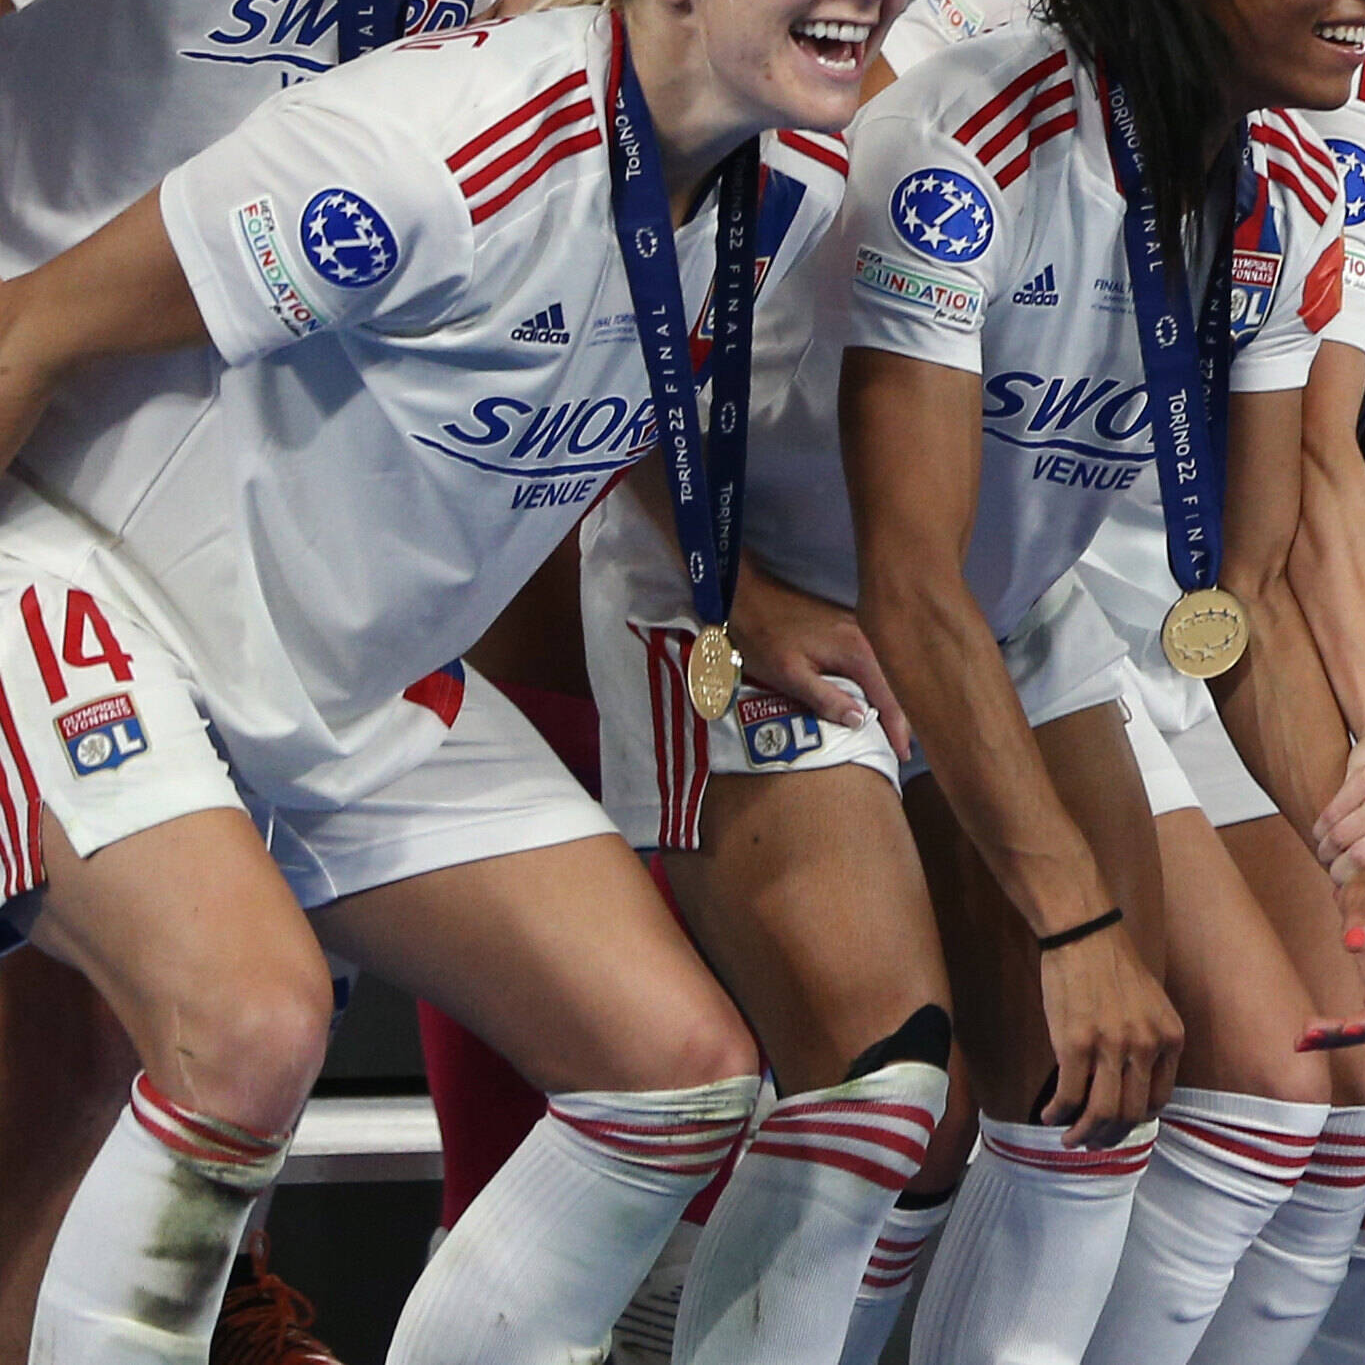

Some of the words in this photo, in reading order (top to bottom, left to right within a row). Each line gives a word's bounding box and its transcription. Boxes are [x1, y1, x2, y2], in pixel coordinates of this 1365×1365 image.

[1109, 85, 1140, 151] TORINO
[615, 117, 641, 181] TORINO
[729, 226, 744, 250] 22
[244, 203, 322, 332] FOUNDATION
[856, 260, 979, 313] FOUNDATION
[1231, 269, 1274, 285] YONNAIS
[1232, 258, 1275, 274] LYMPIQUE
[725, 263, 741, 353] FINAL
[1231, 288, 1263, 325] OL
[510, 327, 570, 345] adidas
[651, 304, 679, 394] FINAL
[669, 406, 685, 432] 22
[1169, 389, 1190, 456] TORINO
[674, 436, 693, 503] TORINO
[1032, 455, 1143, 491] VENUE
[1178, 459, 1197, 484] 22
[510, 478, 597, 510] VENUE
[1183, 495, 1207, 580] FINAL
[20, 584, 134, 704] 14
[63, 698, 128, 729] OLYMPIQUE
[66, 707, 131, 736] LYONNAIS
[76, 724, 142, 767] OL
[754, 716, 819, 757] OL
